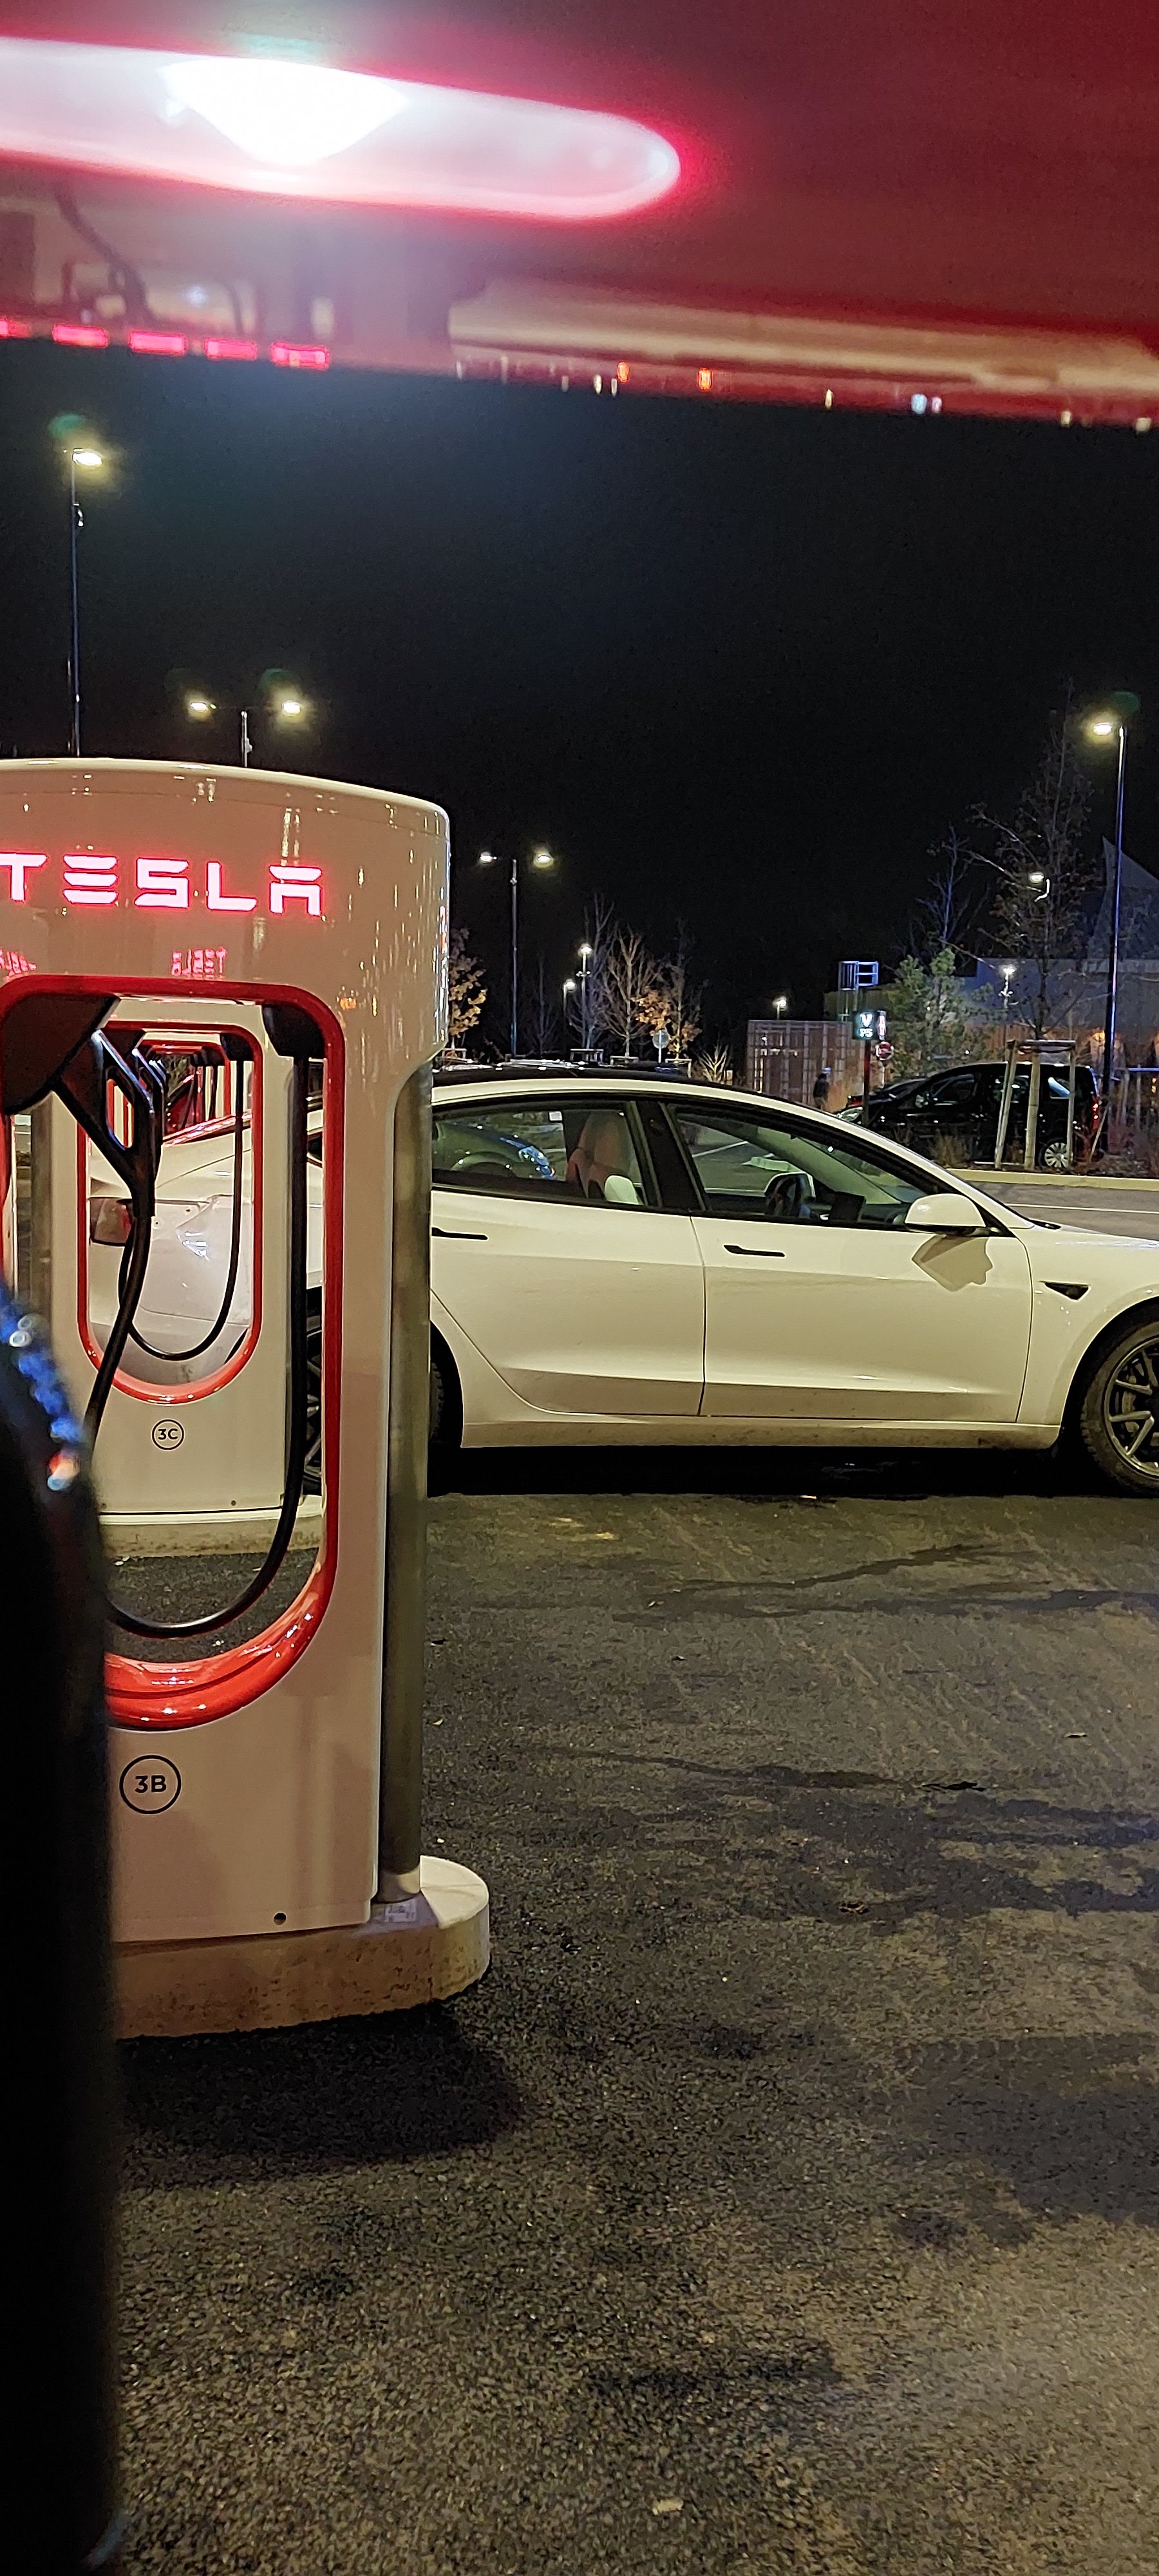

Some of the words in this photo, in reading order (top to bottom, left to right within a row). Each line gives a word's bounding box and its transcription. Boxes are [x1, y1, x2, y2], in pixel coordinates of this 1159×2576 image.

[0, 853, 322, 915] TESLA
[158, 1428, 178, 1440] 3C
[135, 1775, 167, 1794] 3B
